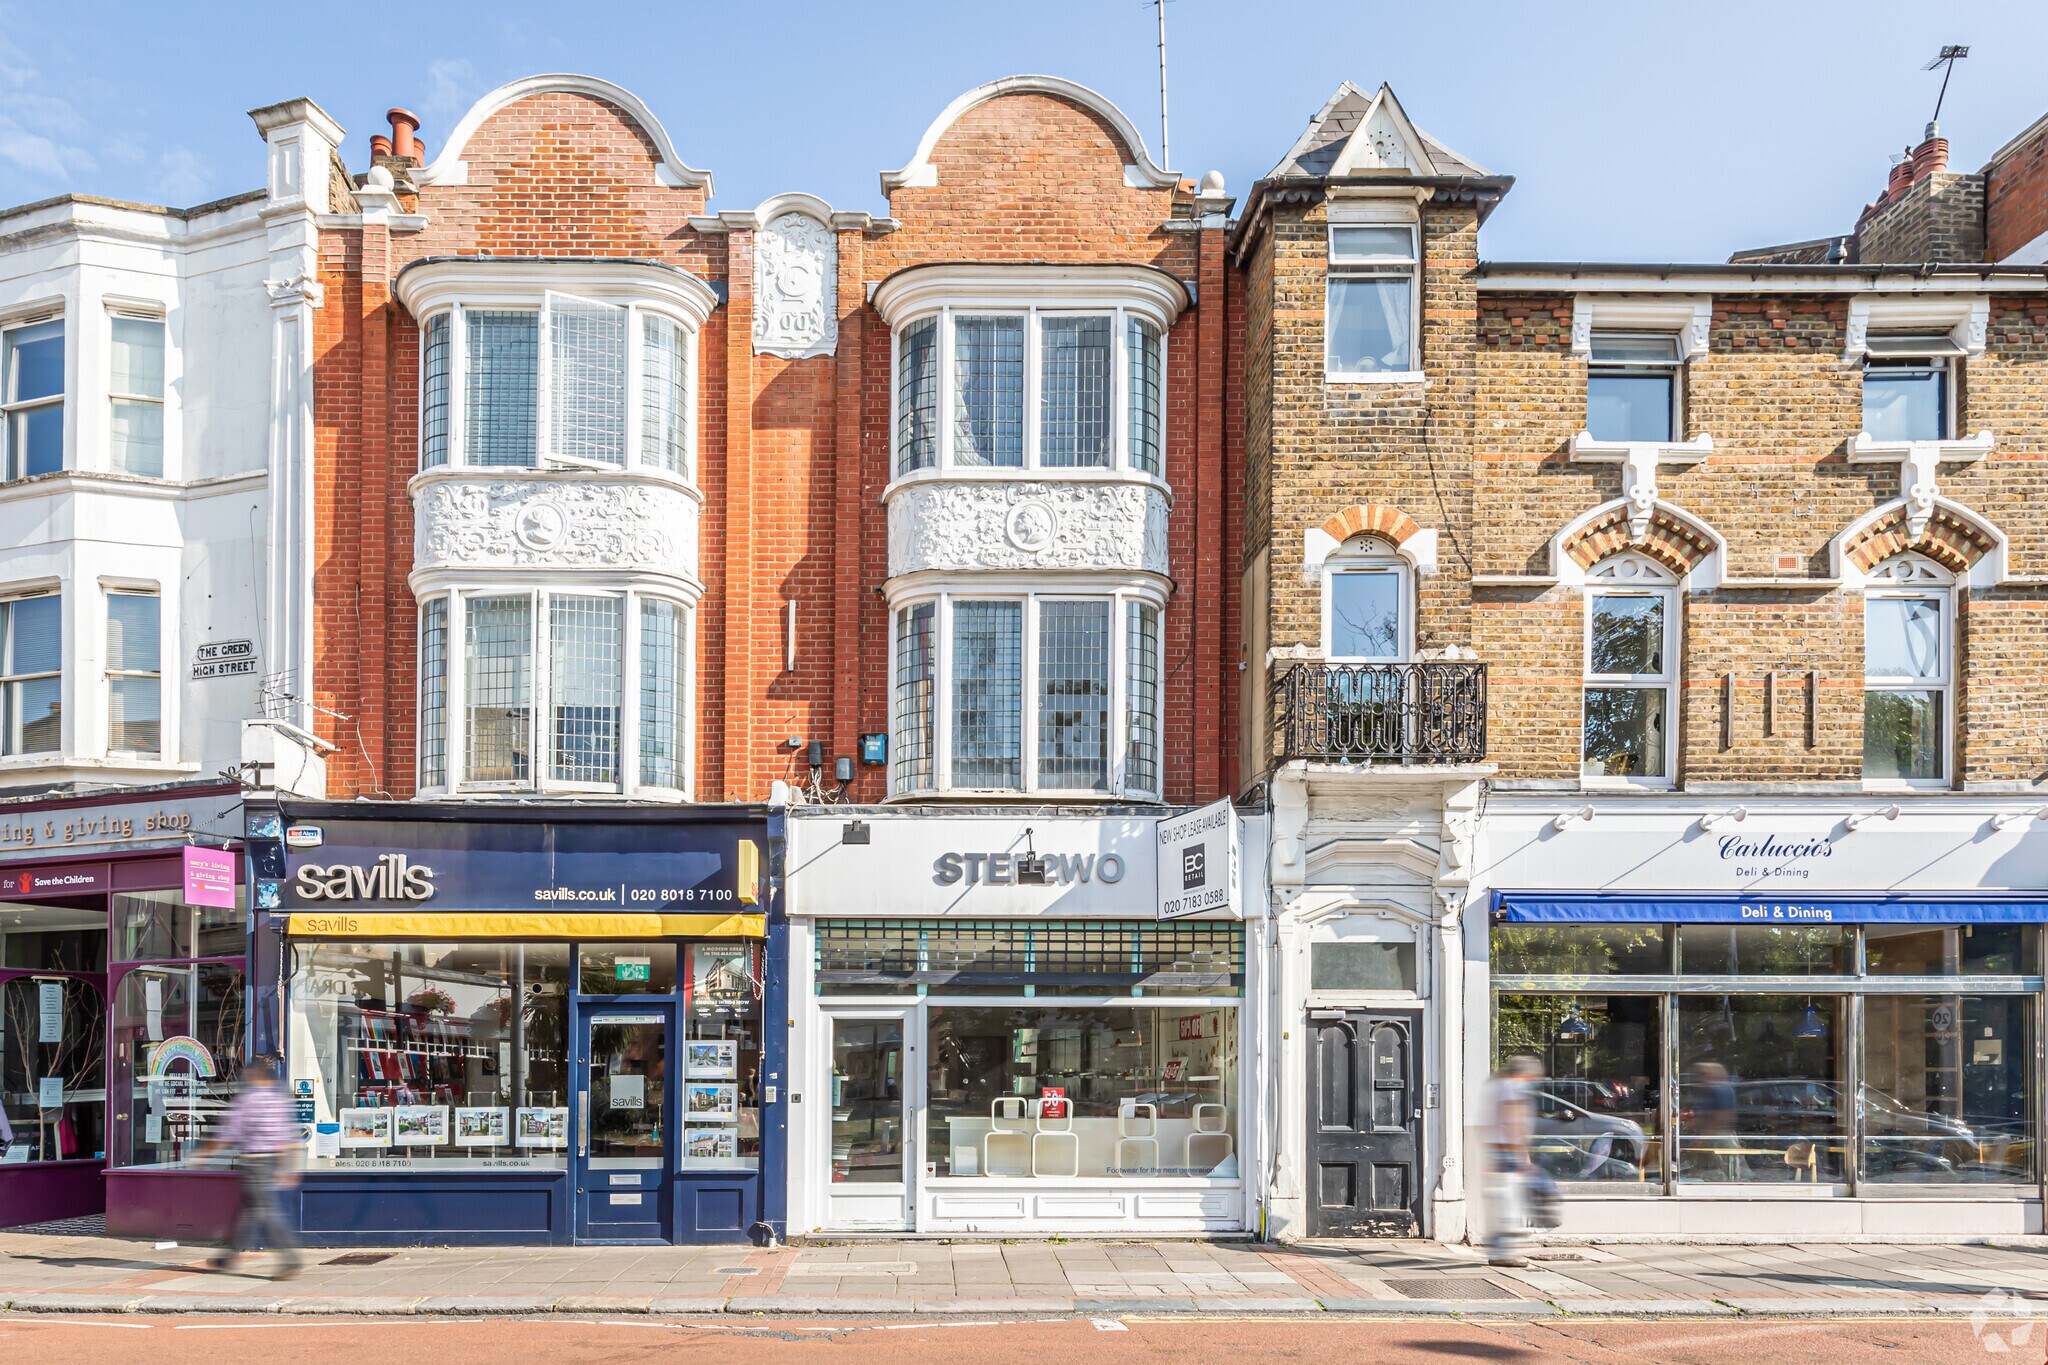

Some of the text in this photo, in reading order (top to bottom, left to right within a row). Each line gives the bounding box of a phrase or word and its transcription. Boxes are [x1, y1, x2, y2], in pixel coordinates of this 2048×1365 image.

[200, 643, 250, 658] THE GREEN
[193, 661, 256, 676] HIGH STREET
[0, 809, 192, 845] ing & giving shop
[1159, 810, 1226, 845] NEW SHOP LEASE AVAILABLE
[1718, 834, 1833, 860] Carluccio's
[1185, 853, 1204, 873] BC
[296, 853, 435, 900] savills
[1185, 872, 1204, 882] RETAIL
[1736, 867, 1810, 879] Deli & Dining
[3, 874, 94, 889] for Save the Children
[534, 886, 733, 901] savills.co.uk 020 8018 7100
[1164, 900, 1180, 914] 020
[1183, 894, 1202, 910] 7183
[1205, 889, 1224, 905] 0588
[1742, 905, 1833, 920] Deli & Dining
[307, 916, 358, 932] savills
[612, 1096, 643, 1107] savills
[1106, 1166, 1138, 1174] Footwear
[1140, 1166, 1149, 1174] for
[1150, 1166, 1161, 1174] the
[1179, 1166, 1216, 1176] generation
